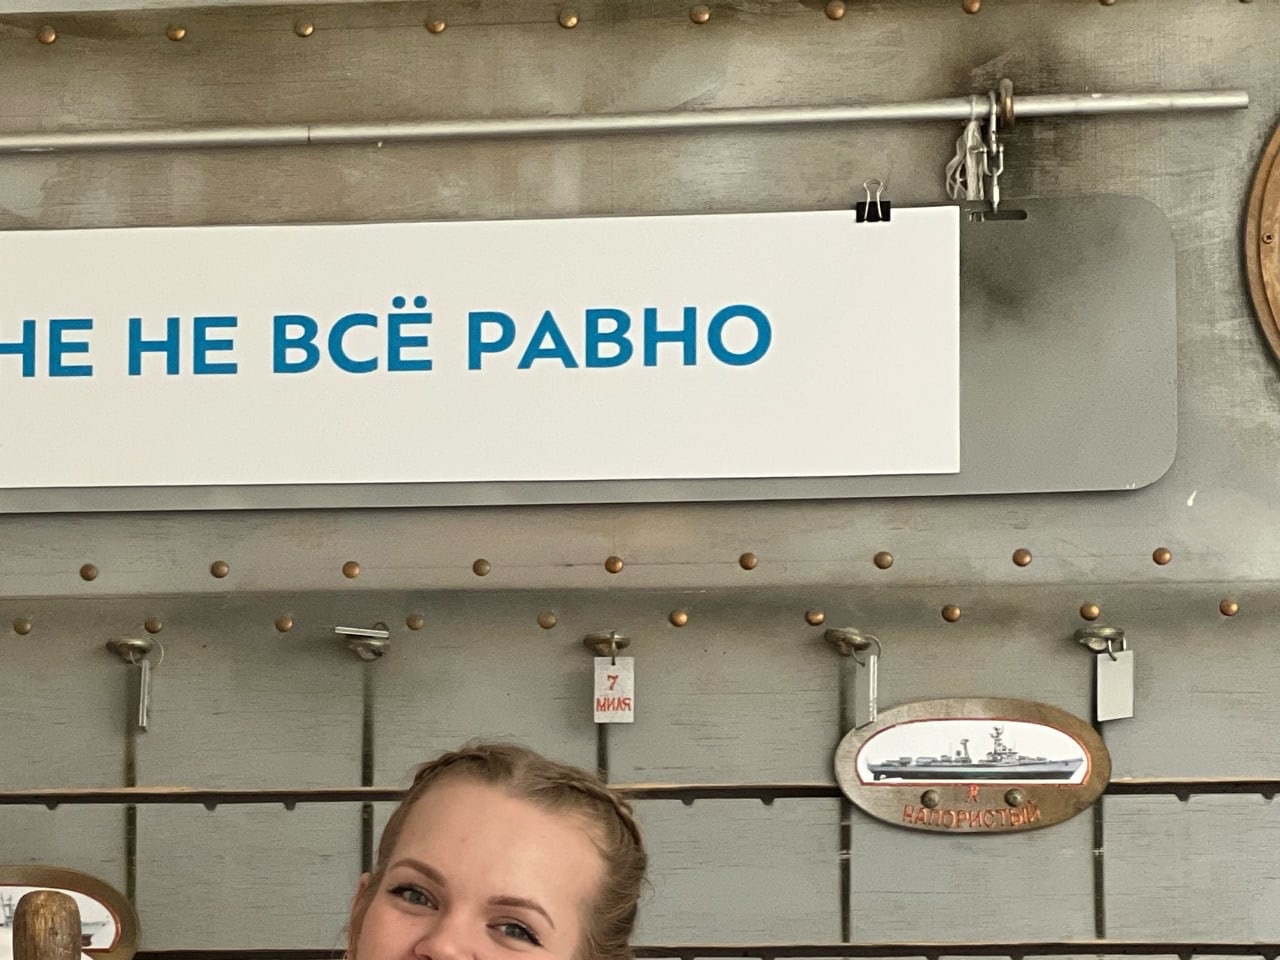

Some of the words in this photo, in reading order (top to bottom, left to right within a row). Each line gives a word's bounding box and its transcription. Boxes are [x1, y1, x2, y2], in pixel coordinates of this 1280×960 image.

[127, 315, 238, 376] НЕ
[272, 294, 433, 374] ВСЁ
[467, 303, 773, 370] РАВНО
[607, 674, 619, 691] 7
[902, 800, 1041, 829] НАПОРИСТЫЙ
